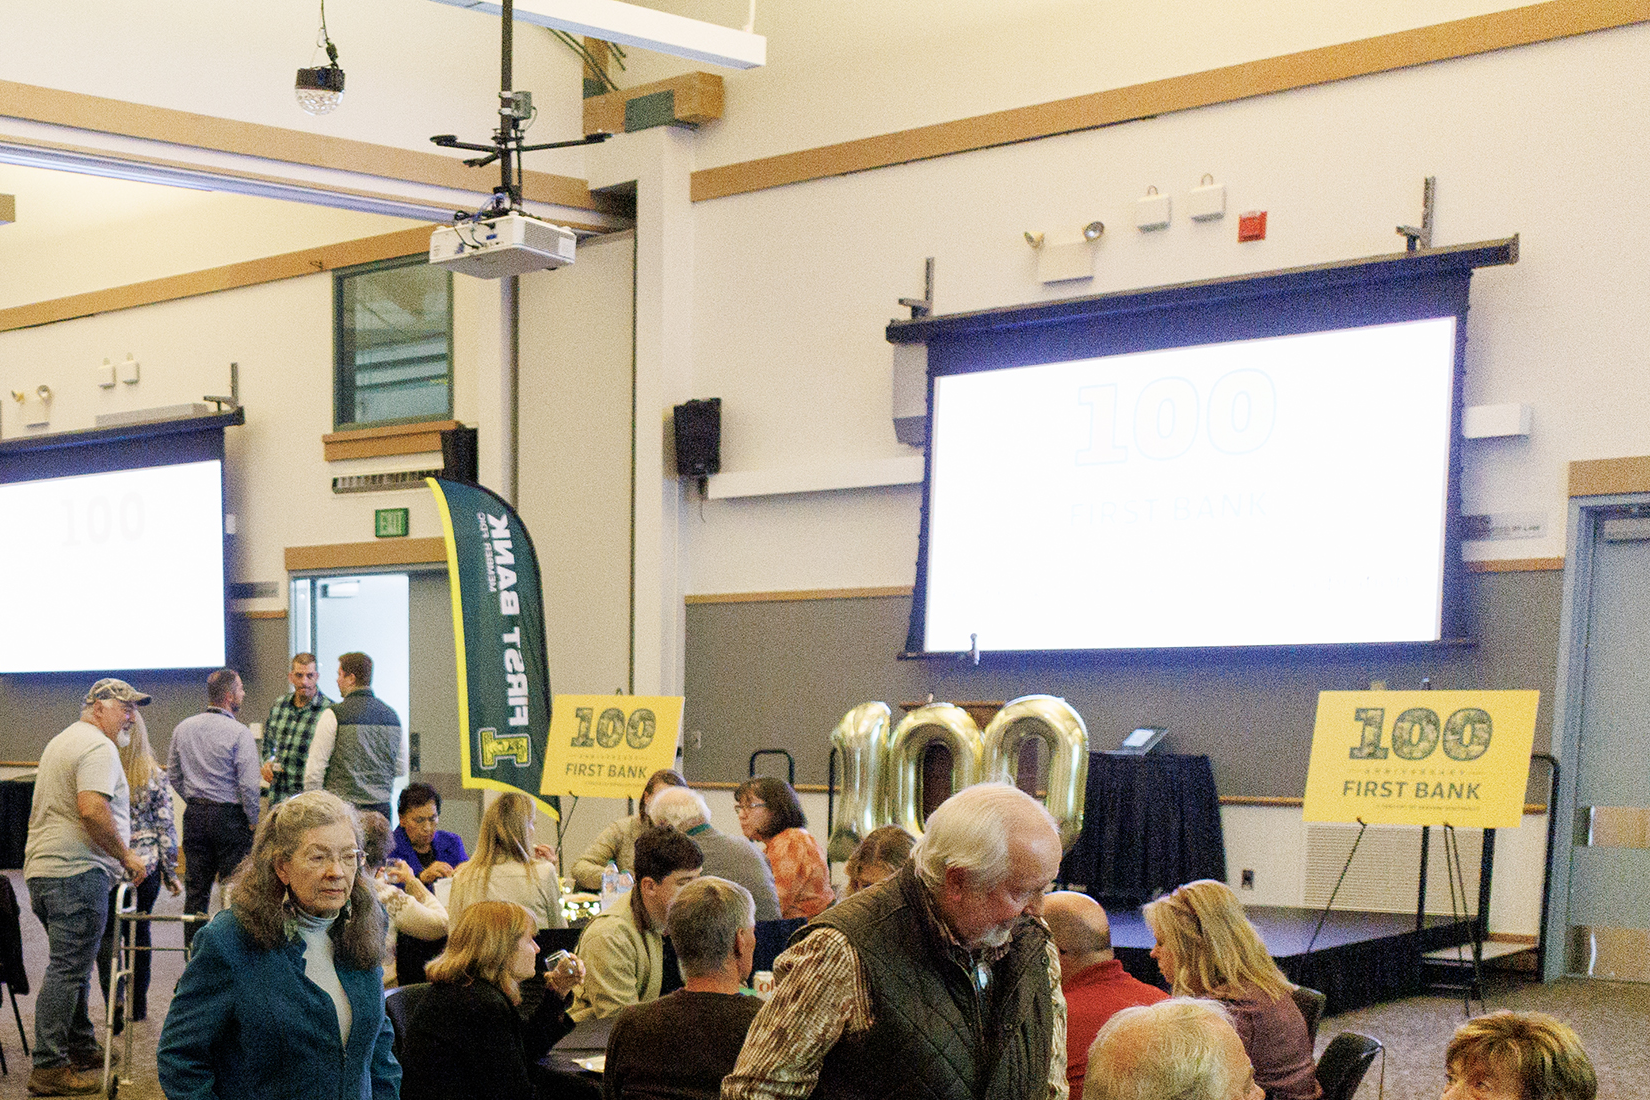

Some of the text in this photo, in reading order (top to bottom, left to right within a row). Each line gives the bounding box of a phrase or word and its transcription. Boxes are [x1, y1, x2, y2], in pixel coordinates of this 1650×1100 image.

[1074, 367, 1278, 468] 100
[60, 490, 147, 547] 100
[1069, 490, 1269, 527] FIRST BANK
[570, 706, 657, 750] 100
[1349, 707, 1494, 762] 100
[565, 763, 649, 779] FIRST BANK
[1343, 780, 1482, 800] FIRST BANK
